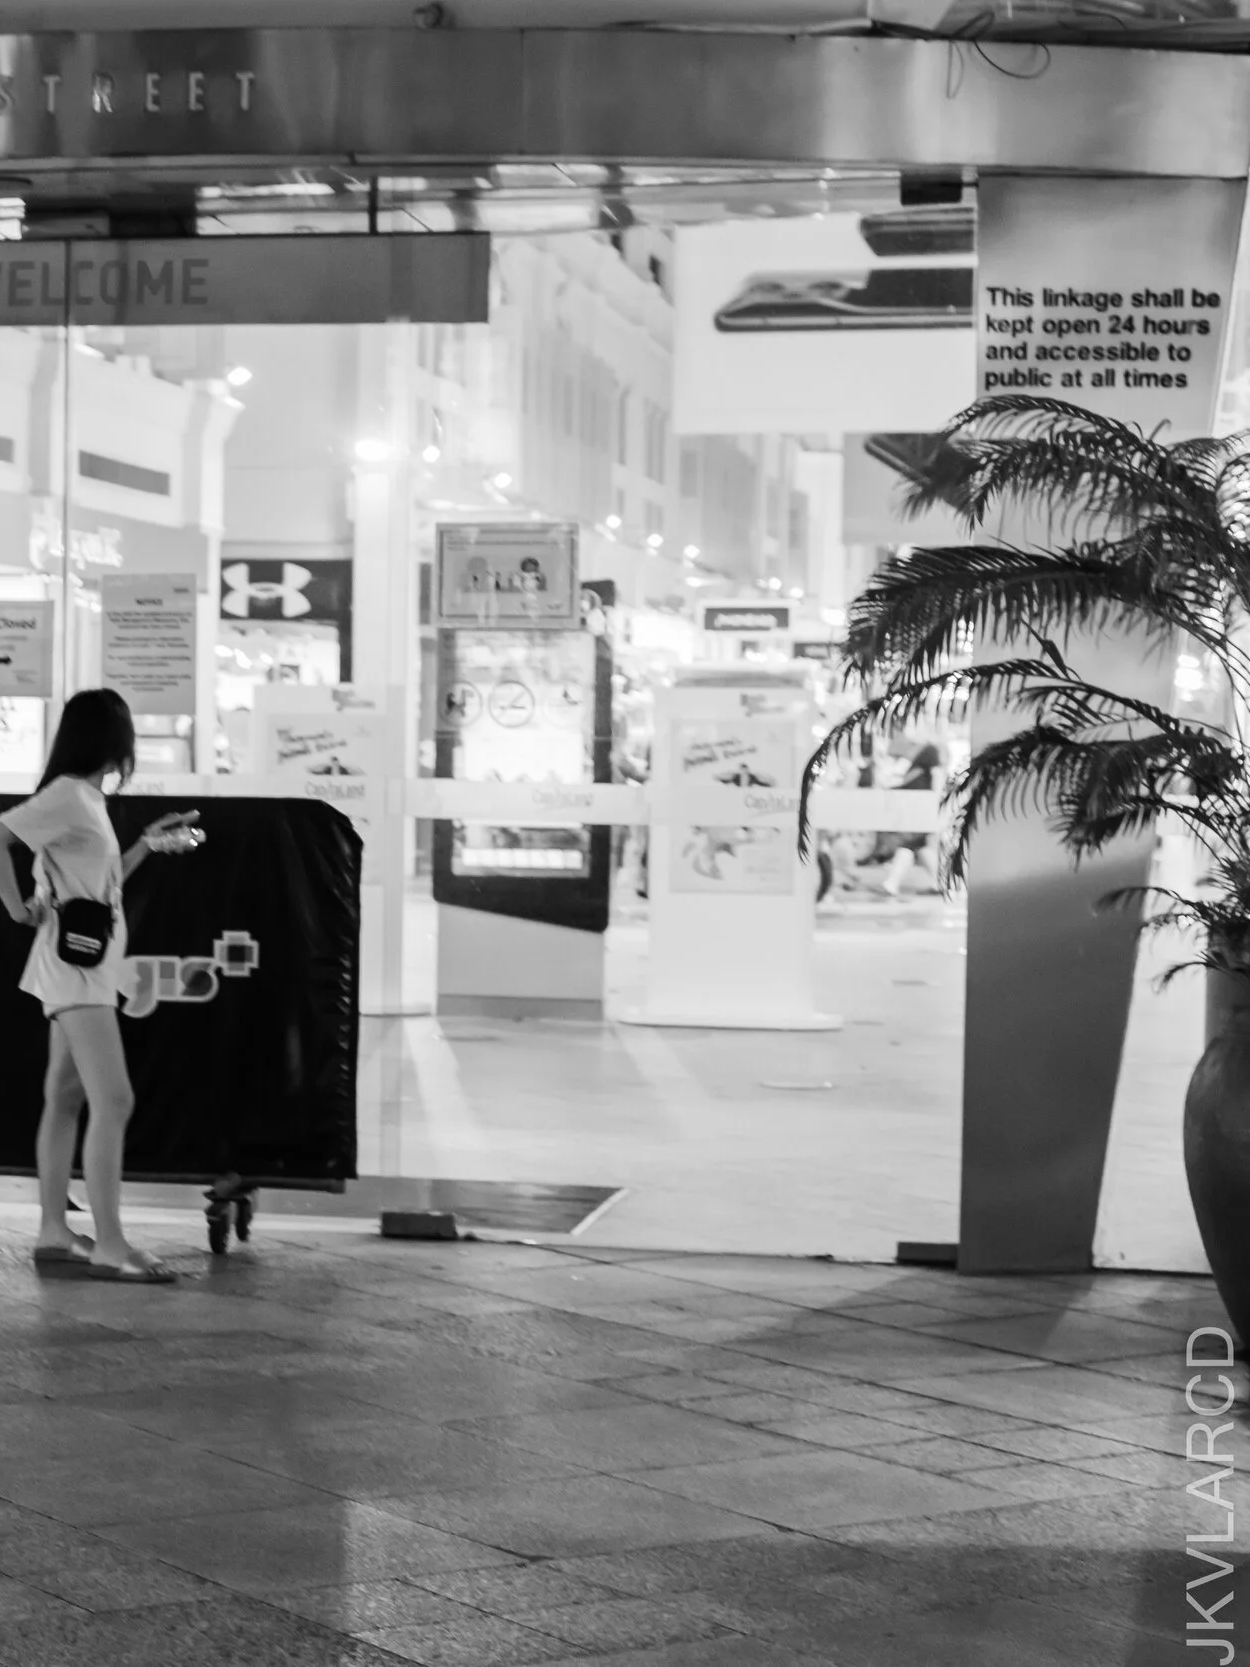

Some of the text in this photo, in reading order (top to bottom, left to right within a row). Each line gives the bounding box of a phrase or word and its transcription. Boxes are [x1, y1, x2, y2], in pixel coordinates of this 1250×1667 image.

[986, 287, 1221, 312] This linkage shall be
[986, 314, 1210, 338] kept open 24 hours
[986, 341, 1191, 362] and accessible to
[984, 368, 1187, 390] public at all times
